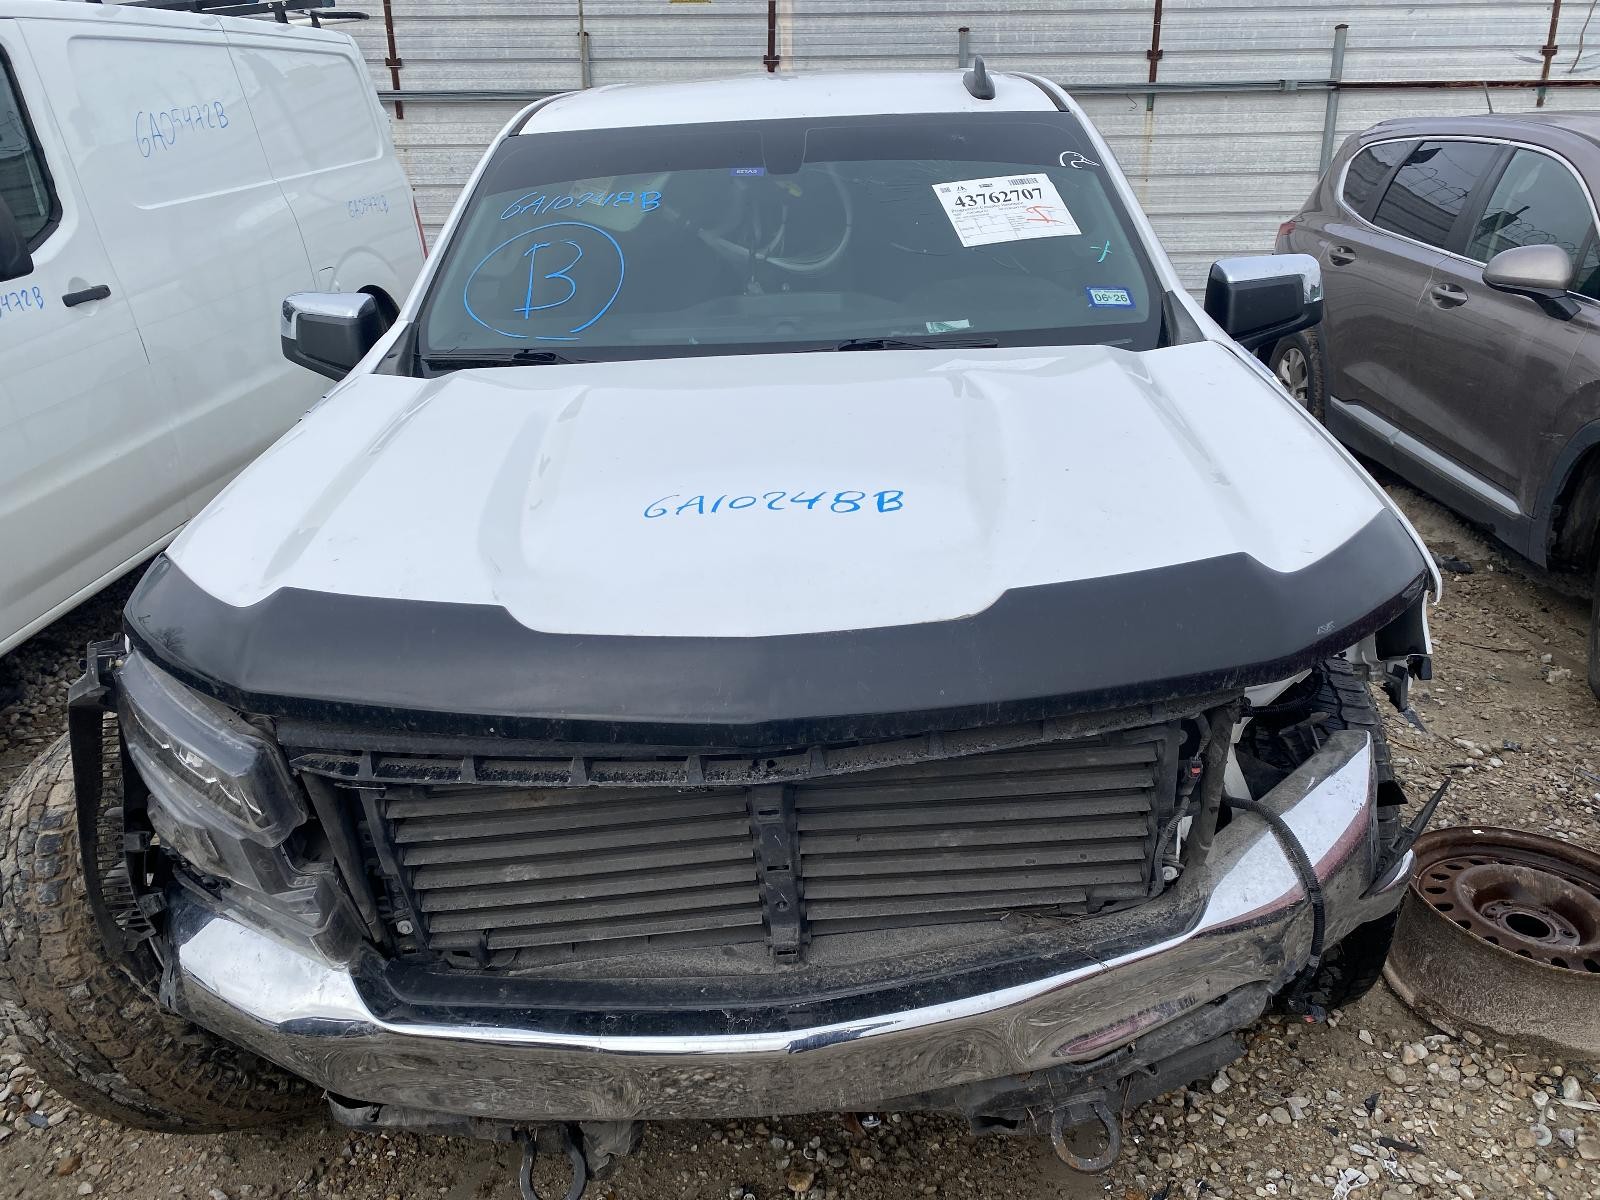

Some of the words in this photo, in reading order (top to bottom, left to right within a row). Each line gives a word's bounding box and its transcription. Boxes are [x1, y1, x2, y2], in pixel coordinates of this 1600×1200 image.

[954, 187, 1042, 208] 43762707
[513, 239, 583, 320] B
[0, 286, 44, 317] 472B
[644, 490, 903, 518] 6A10248B
